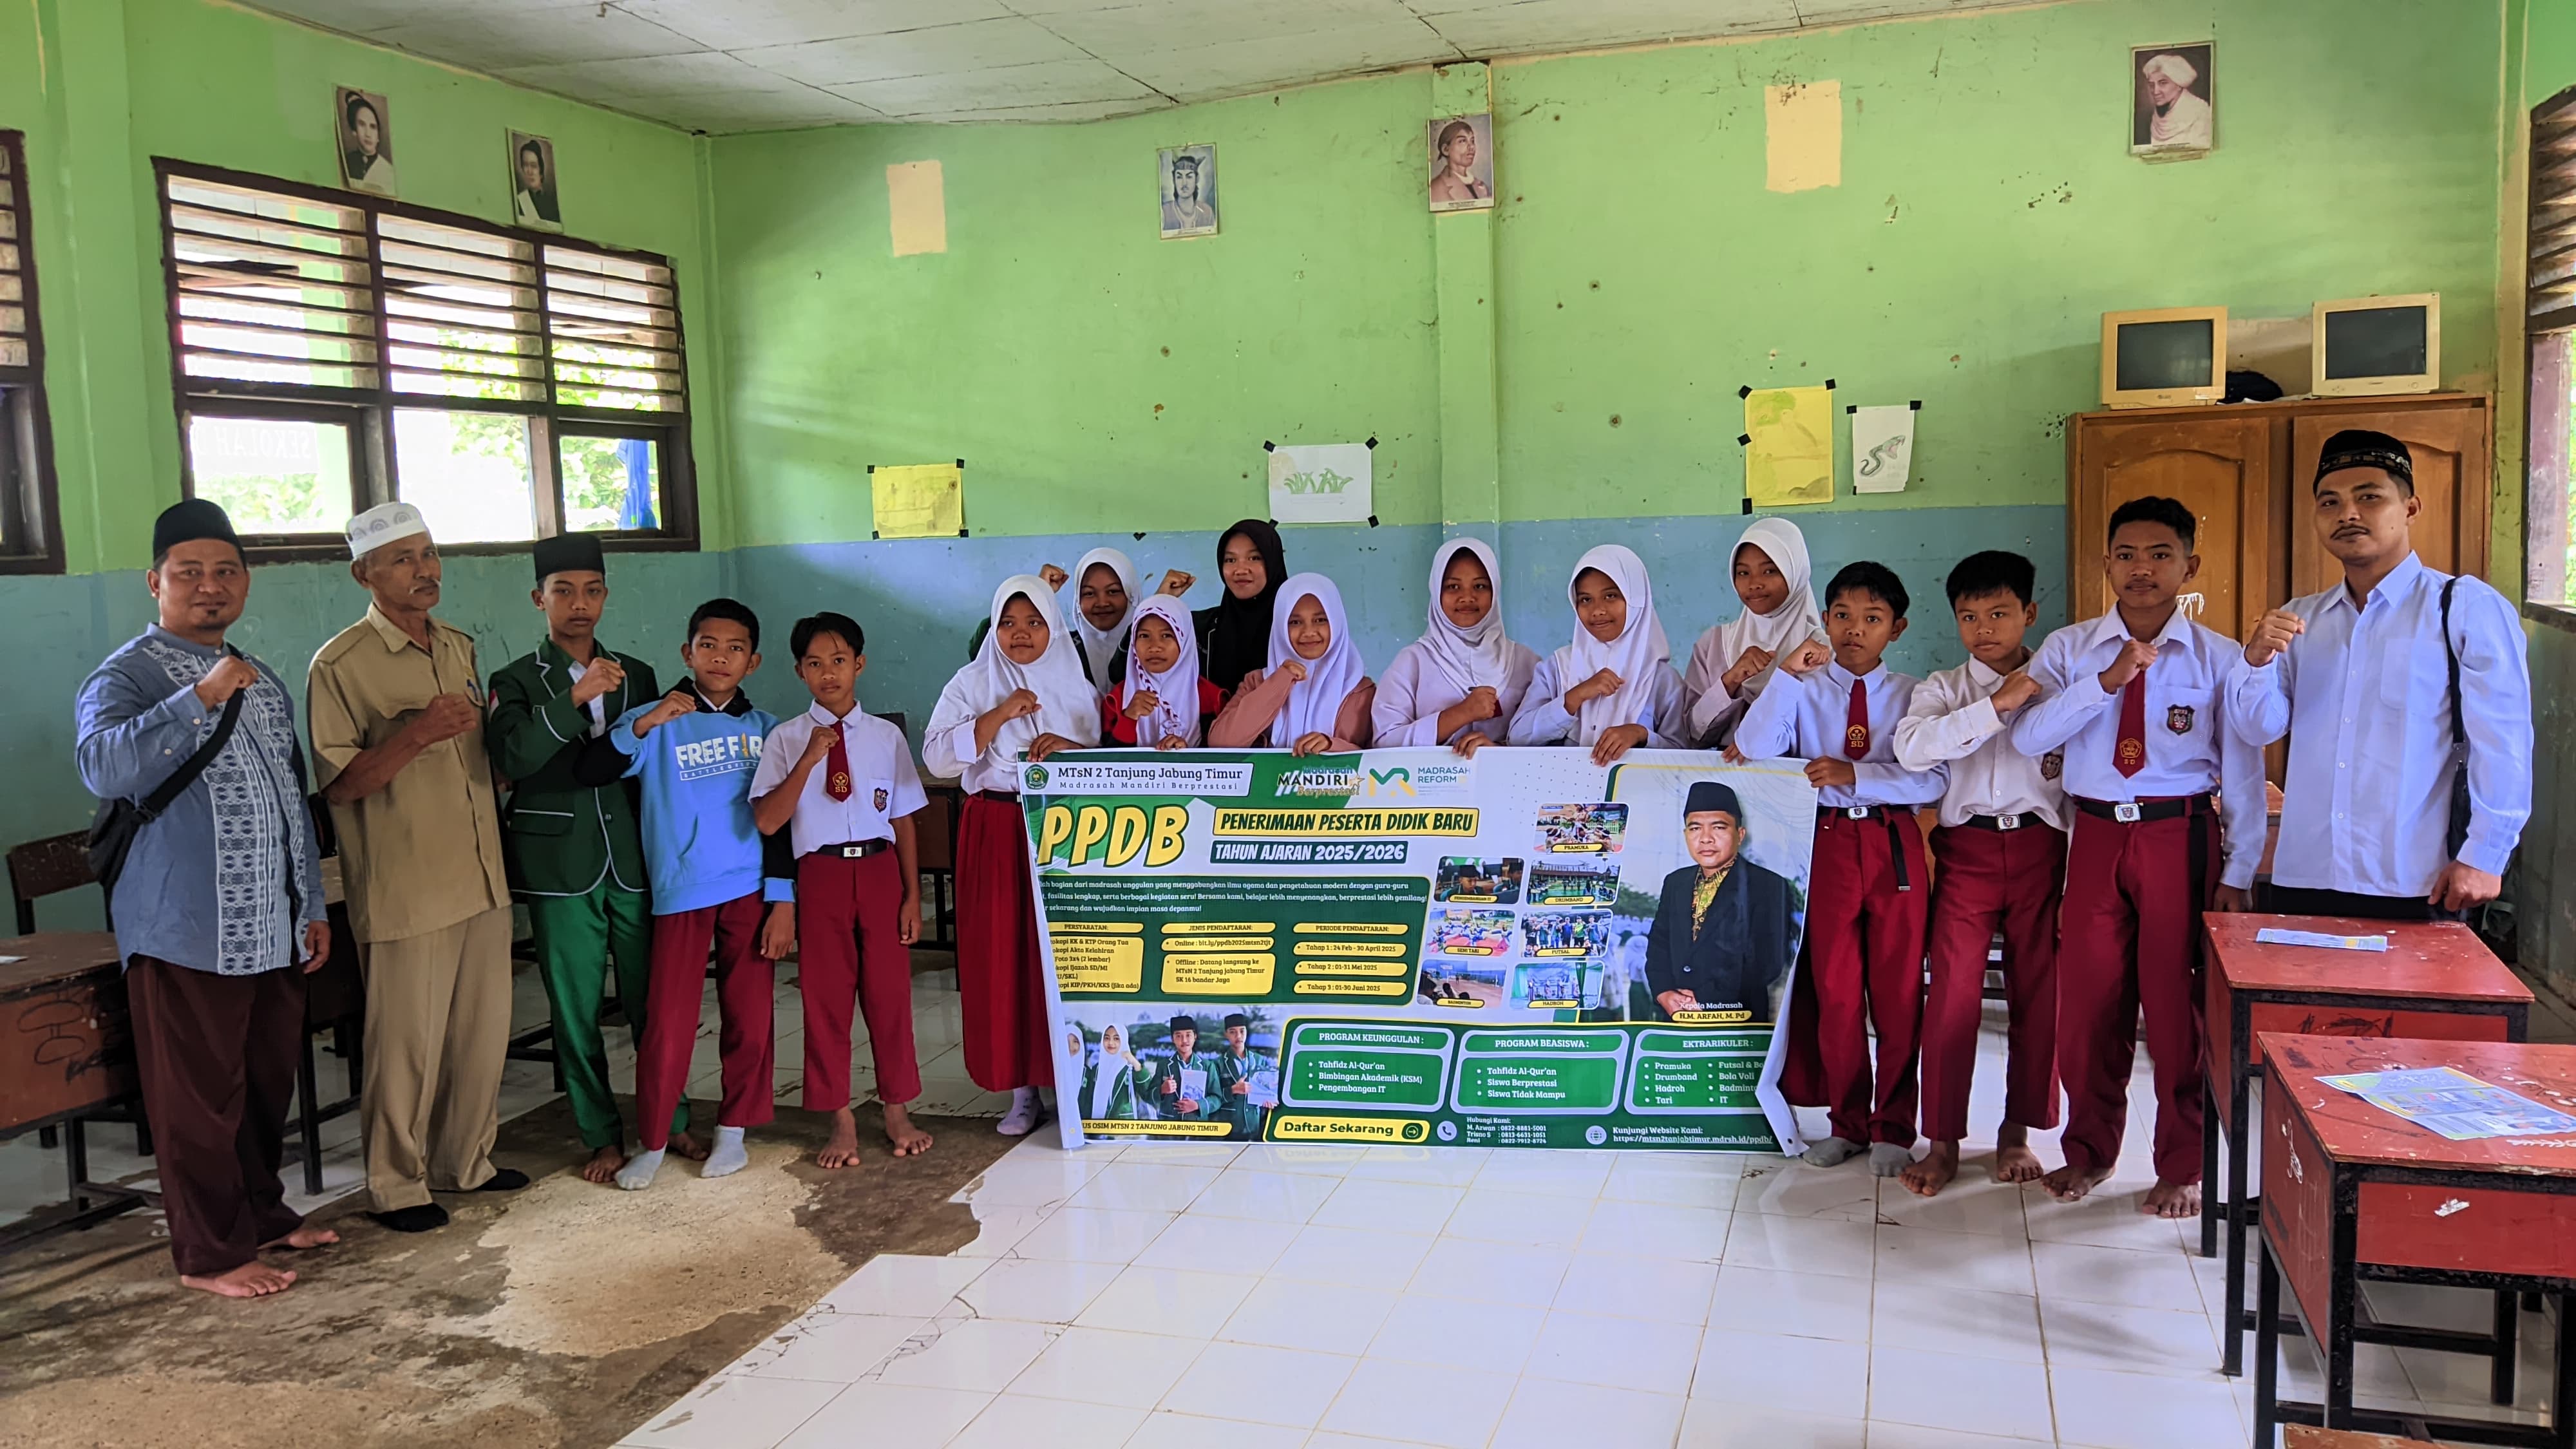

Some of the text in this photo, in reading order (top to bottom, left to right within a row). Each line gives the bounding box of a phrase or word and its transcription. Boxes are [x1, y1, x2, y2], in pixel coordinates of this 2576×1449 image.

[675, 737, 726, 769] FREE
[1058, 768, 1242, 781] MTsN 2 Tanjung Jabung Timur
[1278, 775, 1348, 786] MANDIRI
[1221, 813, 1473, 831] PENERIMAAN PESERTA DIDIK BARU
[1036, 804, 1189, 867] PPDB
[1215, 844, 1405, 860] TAHUN AJARAN 2025/2026
[1170, 905, 1202, 913] depanmu!
[1363, 1034, 1419, 1043] KEUNGGULAN
[1519, 1068, 1557, 1076] Al-Qur'an
[1319, 1072, 1422, 1084] Bimbingan Akademik (KSM)
[1512, 1079, 1557, 1088] Berprestasi
[1319, 1084, 1376, 1094] Pengembangan
[1536, 1091, 1565, 1099] Mampu
[1284, 1122, 1394, 1136] Daftar Sekarang
